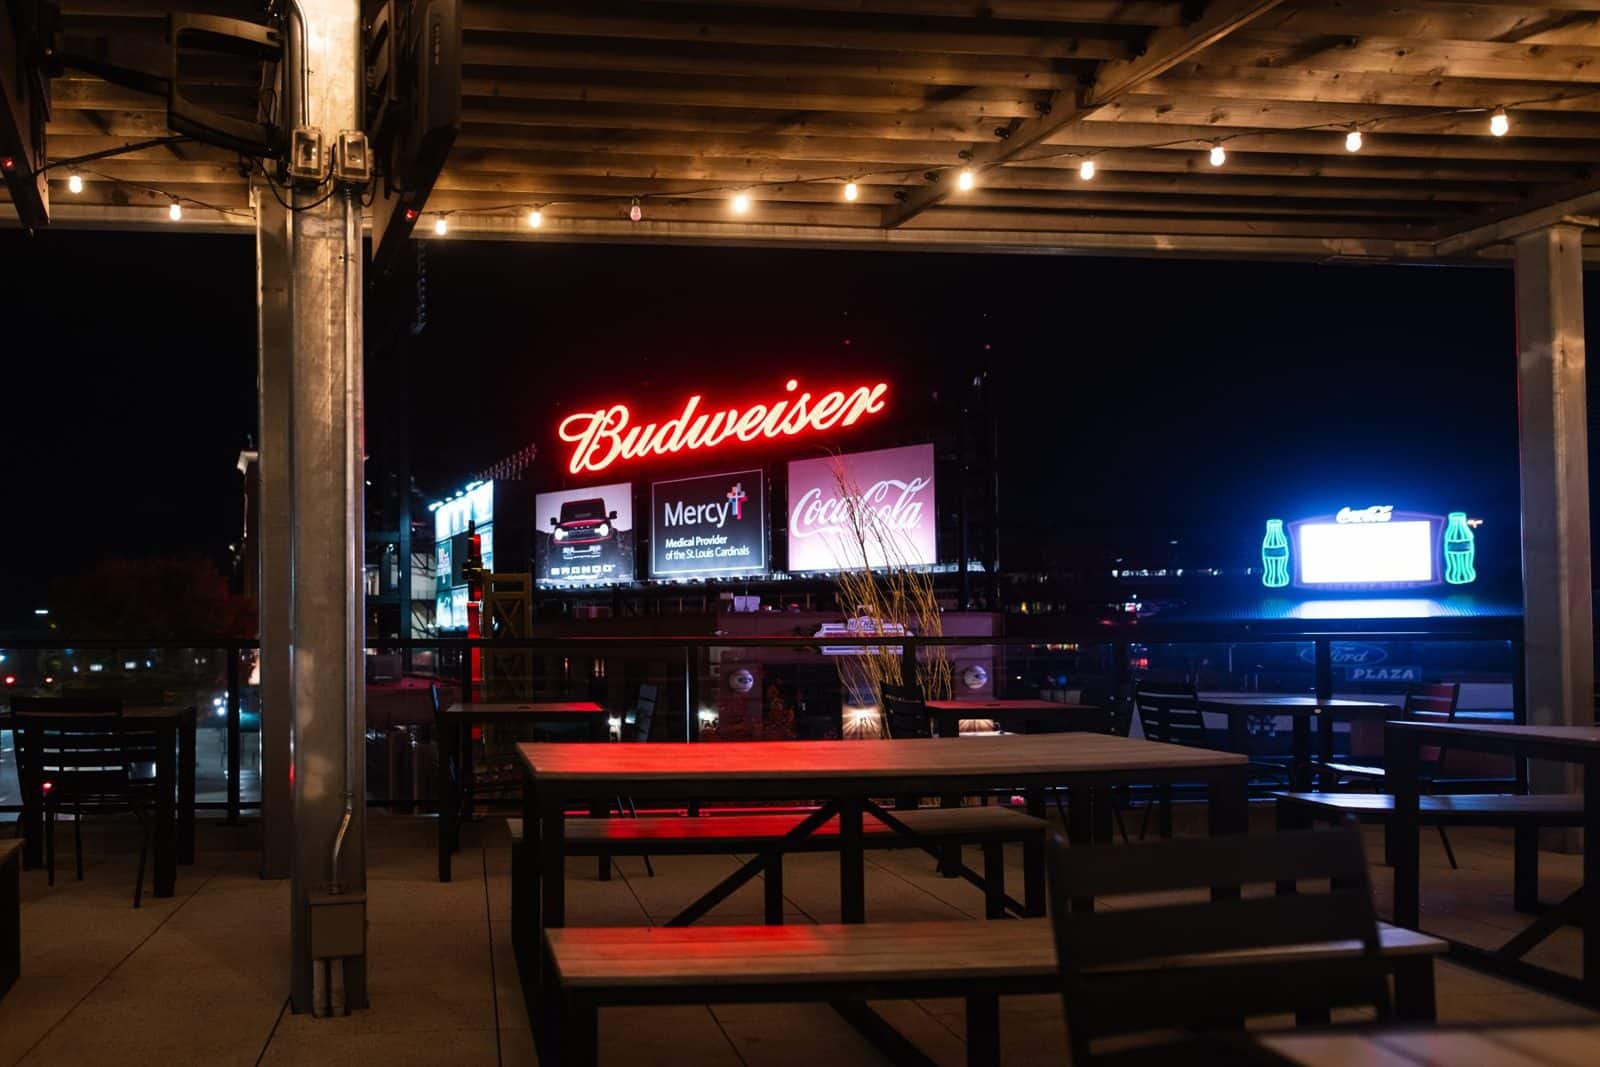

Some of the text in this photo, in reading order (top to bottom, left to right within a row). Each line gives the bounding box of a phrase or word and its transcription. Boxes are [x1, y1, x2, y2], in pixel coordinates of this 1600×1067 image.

[558, 379, 888, 474] Budweiser
[664, 500, 729, 528] Mercy
[665, 534, 728, 549] Medical Provider
[665, 550, 674, 561] of
[674, 549, 686, 560] the
[695, 547, 714, 559] Louis
[715, 545, 750, 558] Cardinals
[1352, 668, 1416, 680] PLAZA
